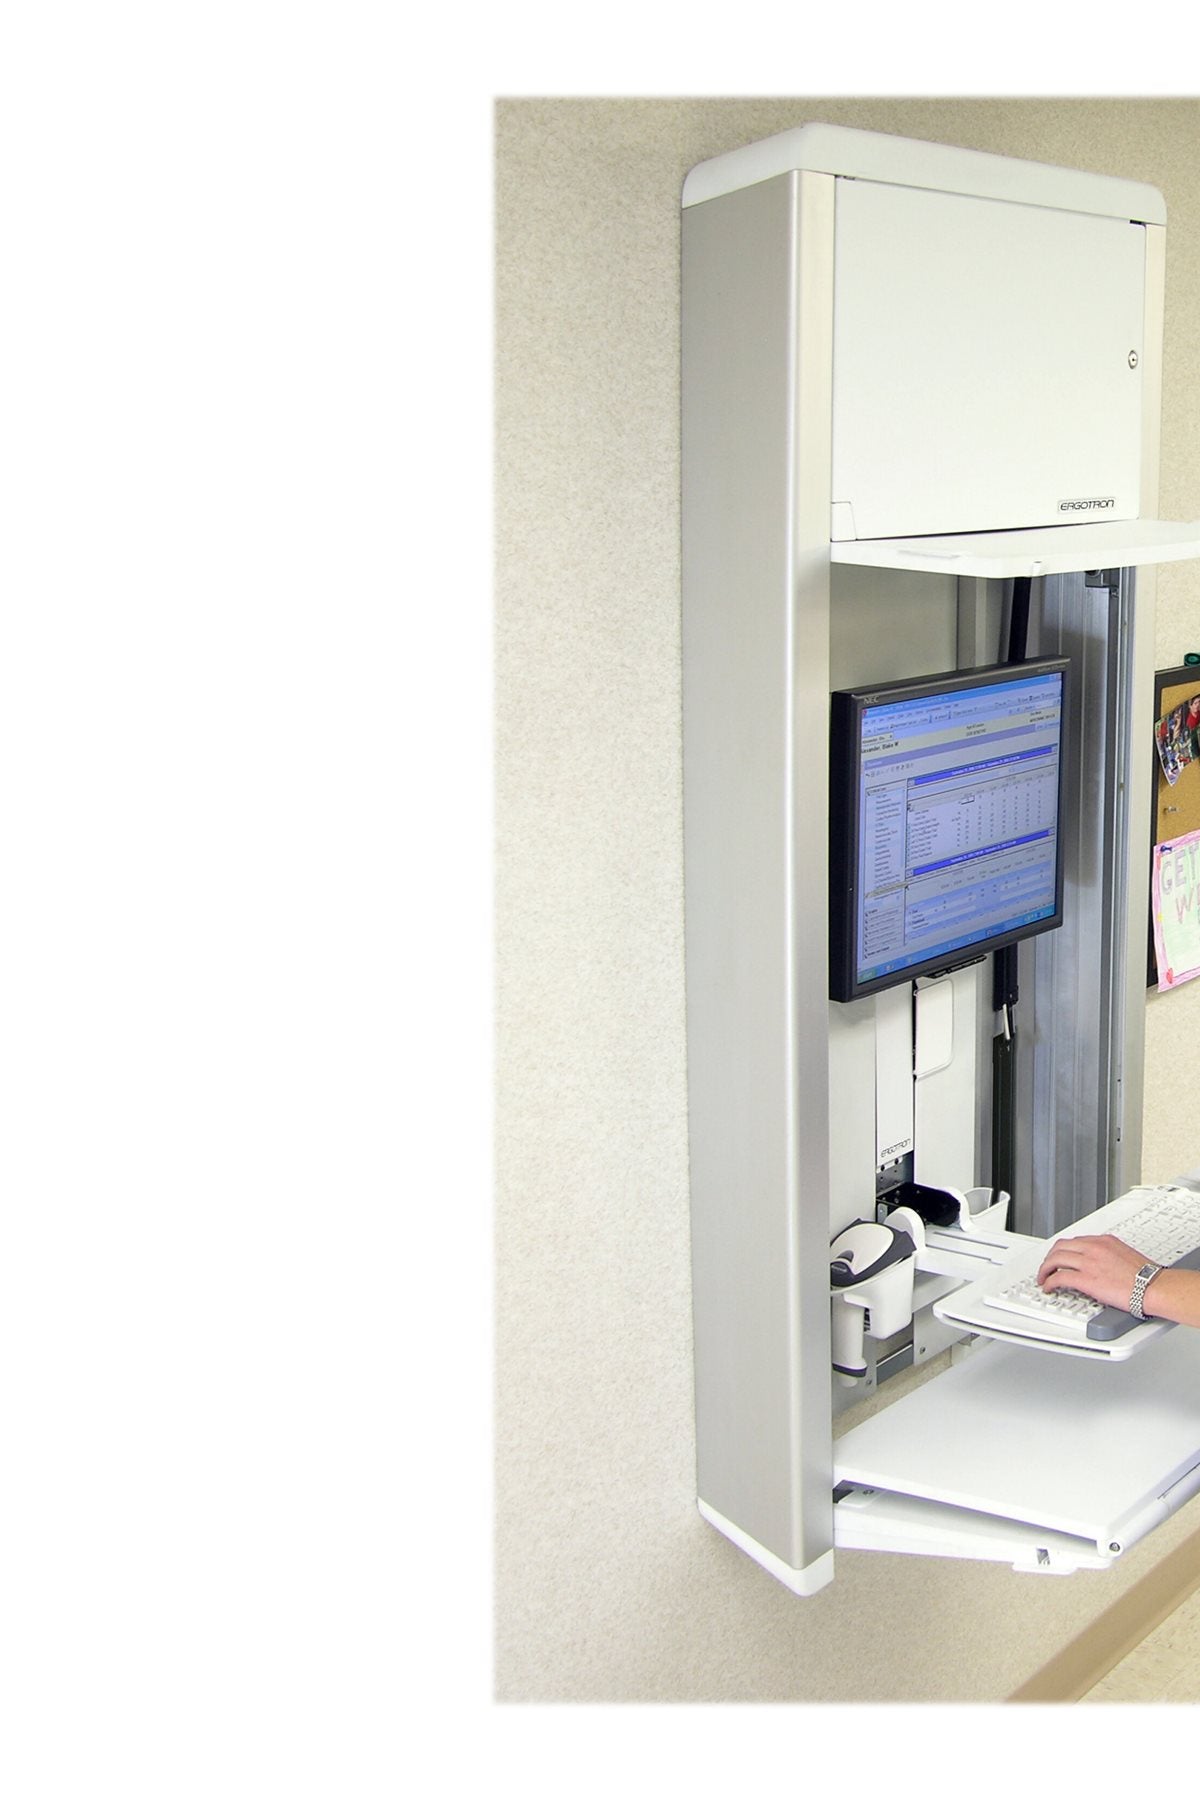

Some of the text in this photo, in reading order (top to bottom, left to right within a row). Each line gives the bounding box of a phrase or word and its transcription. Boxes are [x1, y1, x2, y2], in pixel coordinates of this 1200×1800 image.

[1060, 499, 1114, 511] ERGOTRON
[863, 695, 880, 705] NEC
[1162, 842, 1199, 895] GET
